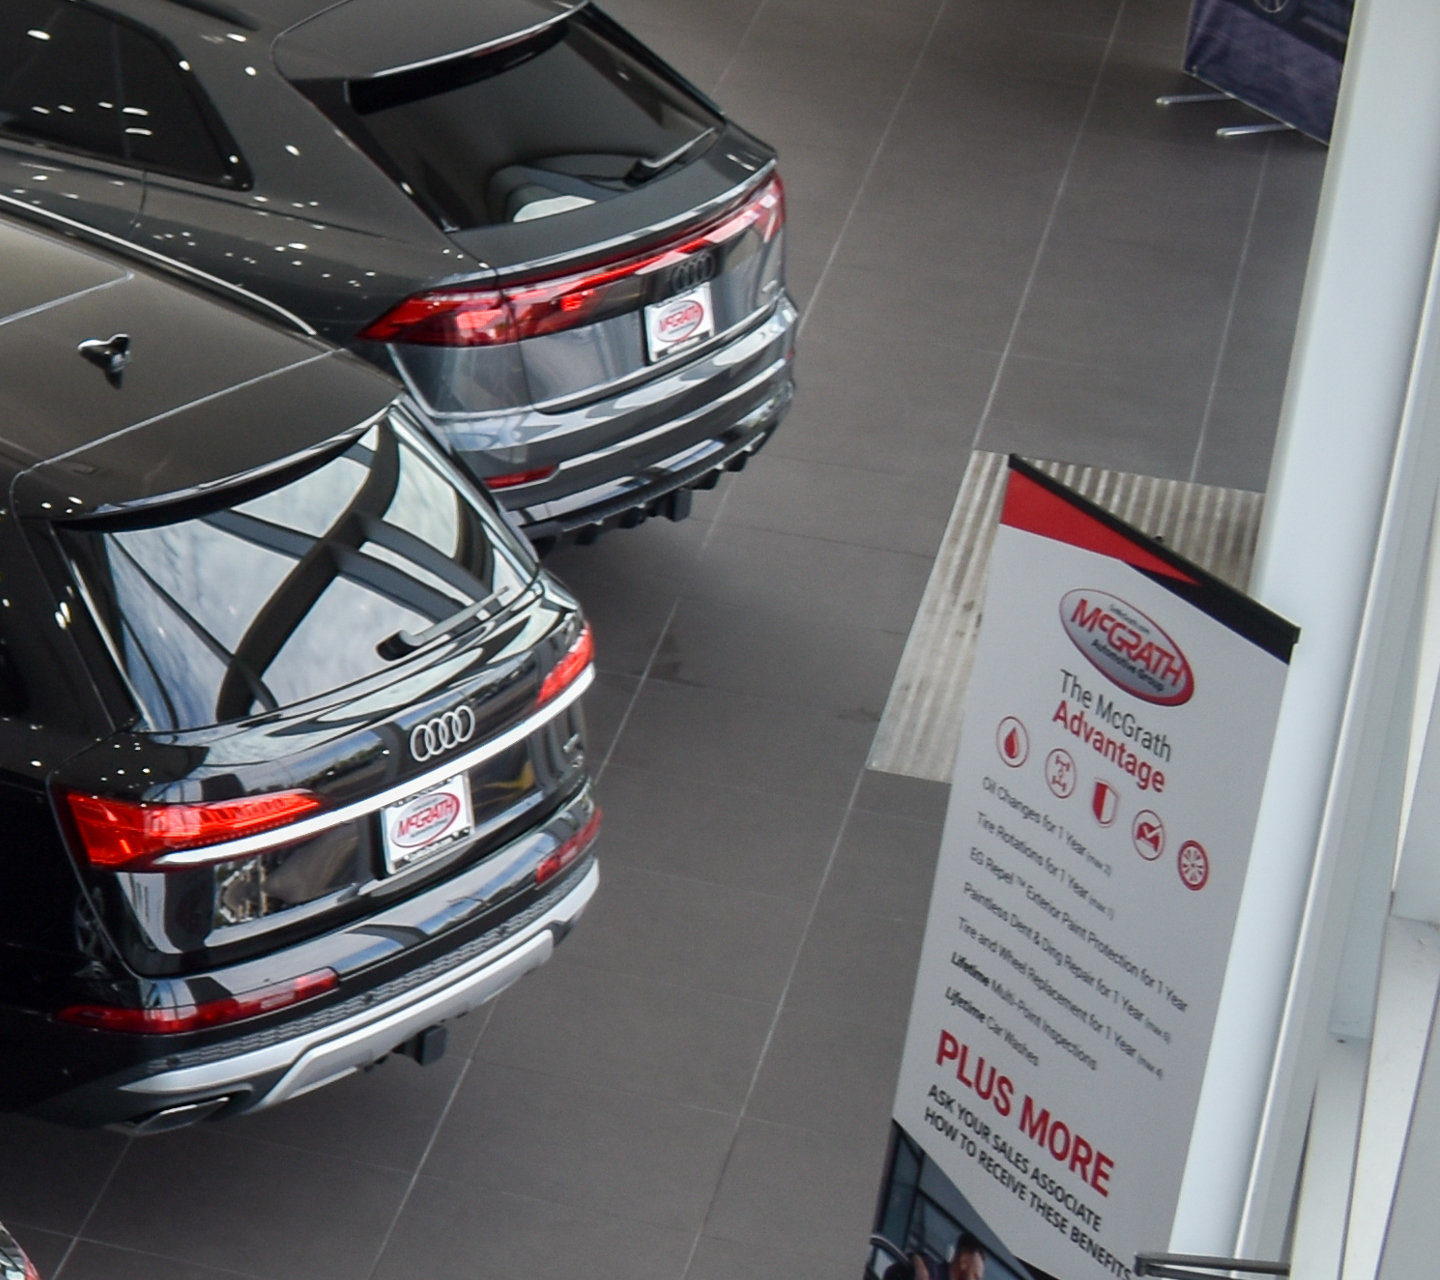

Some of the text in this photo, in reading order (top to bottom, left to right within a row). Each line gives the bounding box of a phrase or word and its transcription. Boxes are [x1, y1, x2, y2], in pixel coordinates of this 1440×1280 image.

[1071, 598, 1183, 686] McGRATH
[1052, 699, 1165, 794] Advantage
[1060, 668, 1172, 763] The McGrath
[978, 811, 996, 834] Tire
[996, 824, 1044, 867] Rotations
[1045, 856, 1059, 877] for
[1060, 868, 1066, 883] 1
[1068, 875, 1089, 899] Year
[982, 776, 997, 794] Oil
[997, 786, 1041, 824] Changes
[1042, 814, 1057, 833] for
[1058, 825, 1064, 840] 1
[1066, 833, 1089, 859] Year
[959, 916, 977, 940] Tire
[977, 933, 998, 953] and
[998, 945, 1028, 975] Wheel
[1027, 967, 1089, 1023] Replacement
[1088, 1013, 1104, 1033] for
[1105, 1025, 1112, 1040] 1
[1114, 1032, 1137, 1058] Year
[963, 881, 1009, 922] Paintless
[1010, 913, 1033, 940] Dent
[1033, 931, 1041, 946] &
[1041, 937, 1064, 967] Ding
[1064, 954, 1096, 987] Repair
[1096, 977, 1112, 998] for
[1113, 989, 1120, 1004] 1
[1122, 996, 1145, 1022] Year
[1025, 884, 1062, 919] Exterior
[1061, 911, 1088, 941] Paint
[1087, 931, 1139, 978] Protection
[1140, 968, 1156, 988] for
[1157, 979, 1164, 995] 1
[1166, 986, 1188, 1013] Year
[944, 986, 1039, 1067] Lifetime Car Washes
[950, 951, 1097, 1071] Lifetime Multi-Point Inspections
[924, 1106, 959, 1142] HOW
[960, 1132, 977, 1158] TO
[978, 1150, 1028, 1201] RECEIVE
[1029, 1191, 1069, 1235] THESE
[927, 1084, 1102, 1233] ASK YOUR SALES ASSOCIATE
[935, 1029, 1115, 1198] PLUS MORE
